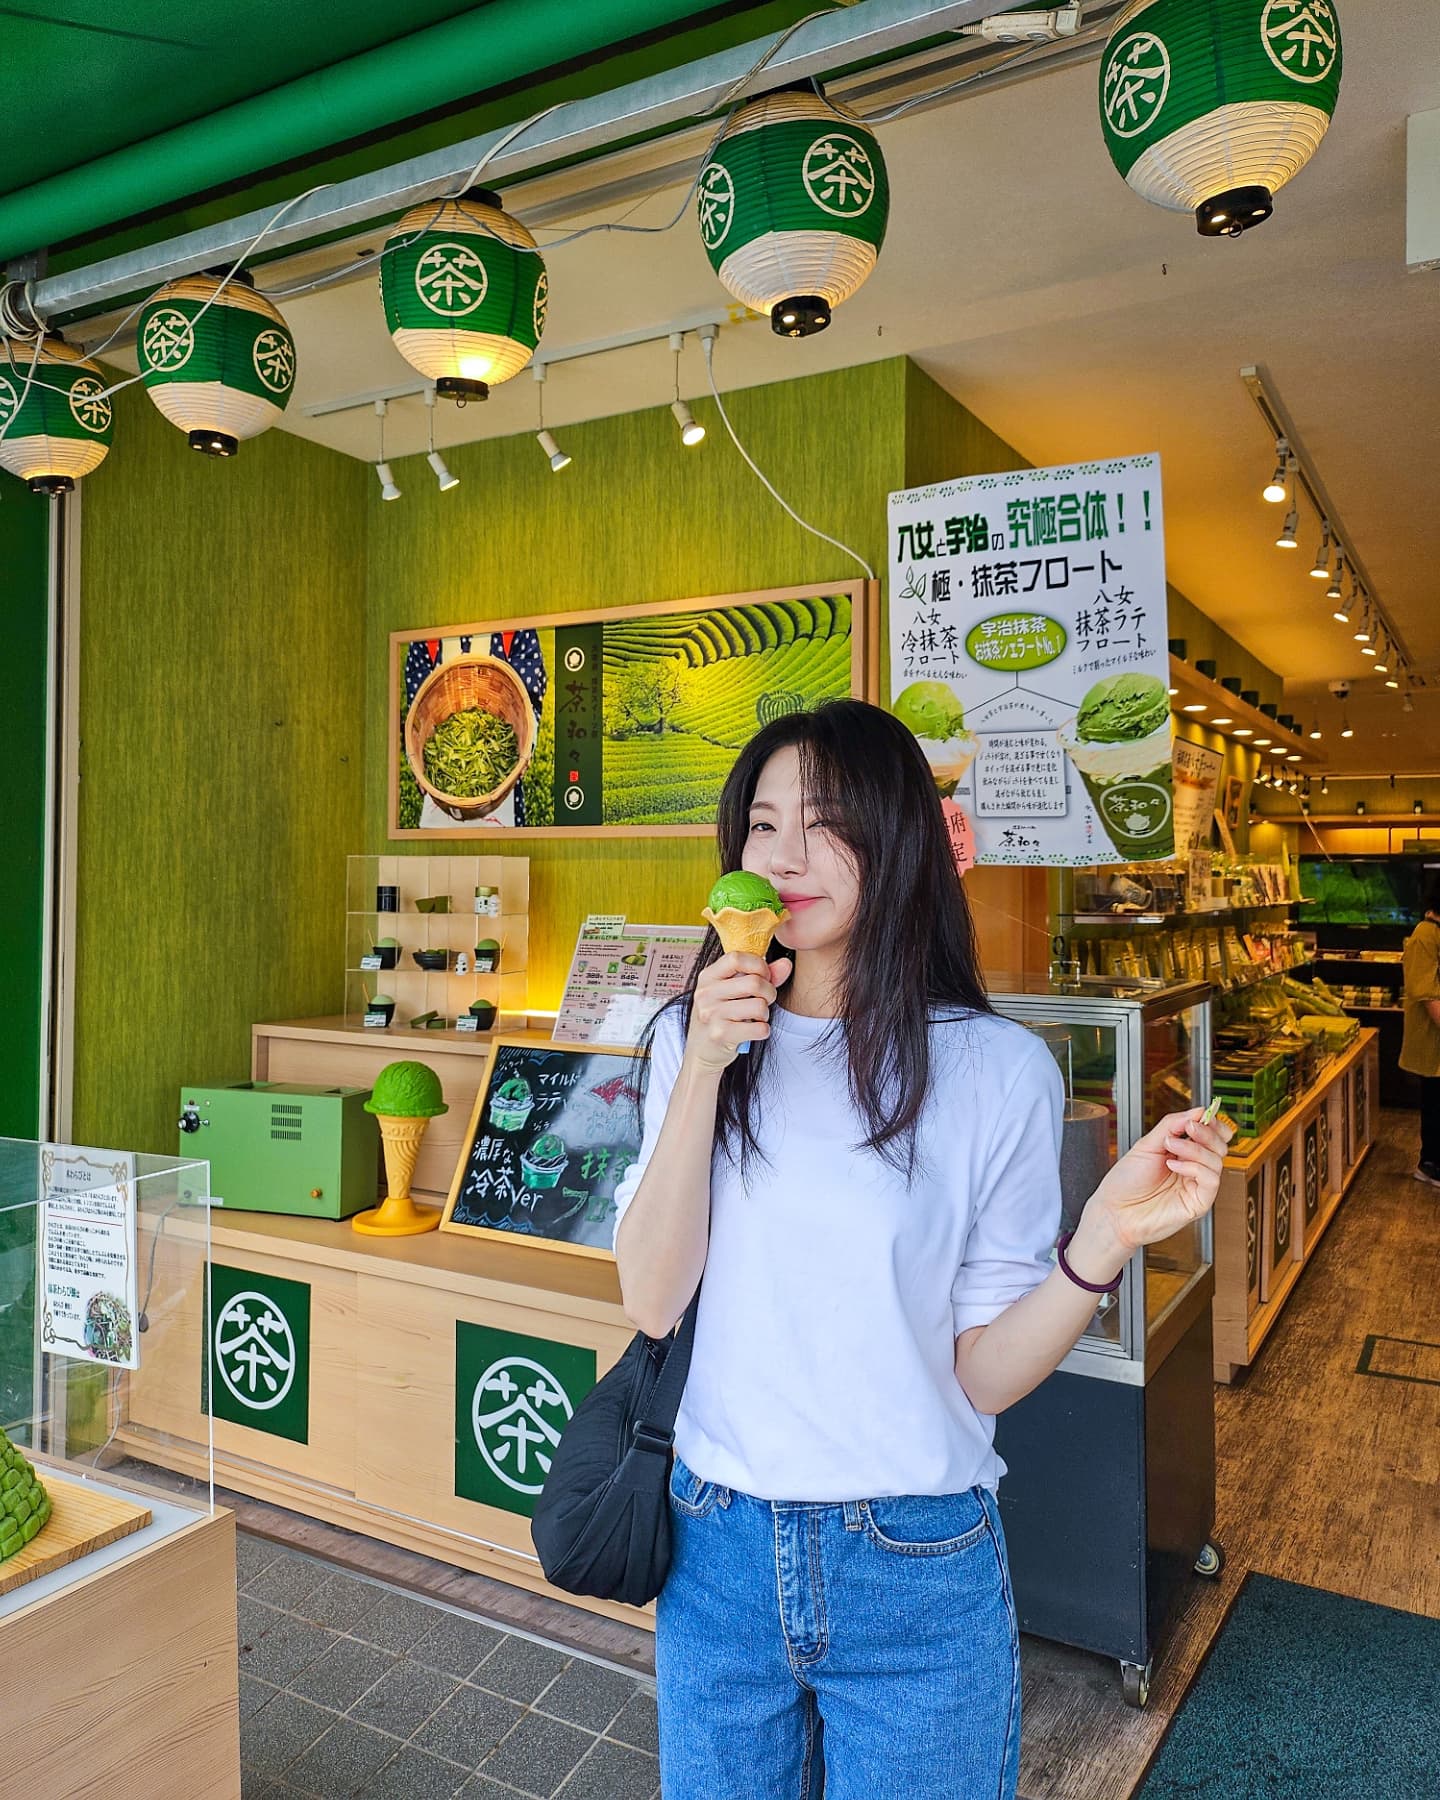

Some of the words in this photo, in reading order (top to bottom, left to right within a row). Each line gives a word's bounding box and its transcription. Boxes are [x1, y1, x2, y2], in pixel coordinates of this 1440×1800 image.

[1266, 0, 1336, 67] 茶
[1105, 41, 1166, 128] 茶
[807, 142, 872, 206] 茶
[700, 171, 732, 241] 茶
[418, 250, 486, 307] 茶
[144, 314, 193, 366] 茶
[255, 333, 295, 388] 茶
[72, 382, 112, 425] 茶
[931, 550, 1123, 603] 極・抹茶フロート
[1092, 585, 1135, 606] 八女
[912, 609, 942, 626] 八女
[980, 617, 1047, 638] 宇治抹茶
[1075, 606, 1146, 637] 抹茶ラテ
[901, 625, 959, 654] 冷抹茶
[903, 650, 960, 667] フロート
[1076, 632, 1147, 653] フロート
[1106, 793, 1161, 813] 茶和々
[998, 828, 1041, 848] 茶和々
[472, 1134, 515, 1164] 濃厚な
[552, 1185, 618, 1225] フロ
[219, 1303, 290, 1393] 茶
[478, 1370, 564, 1475] 茶
